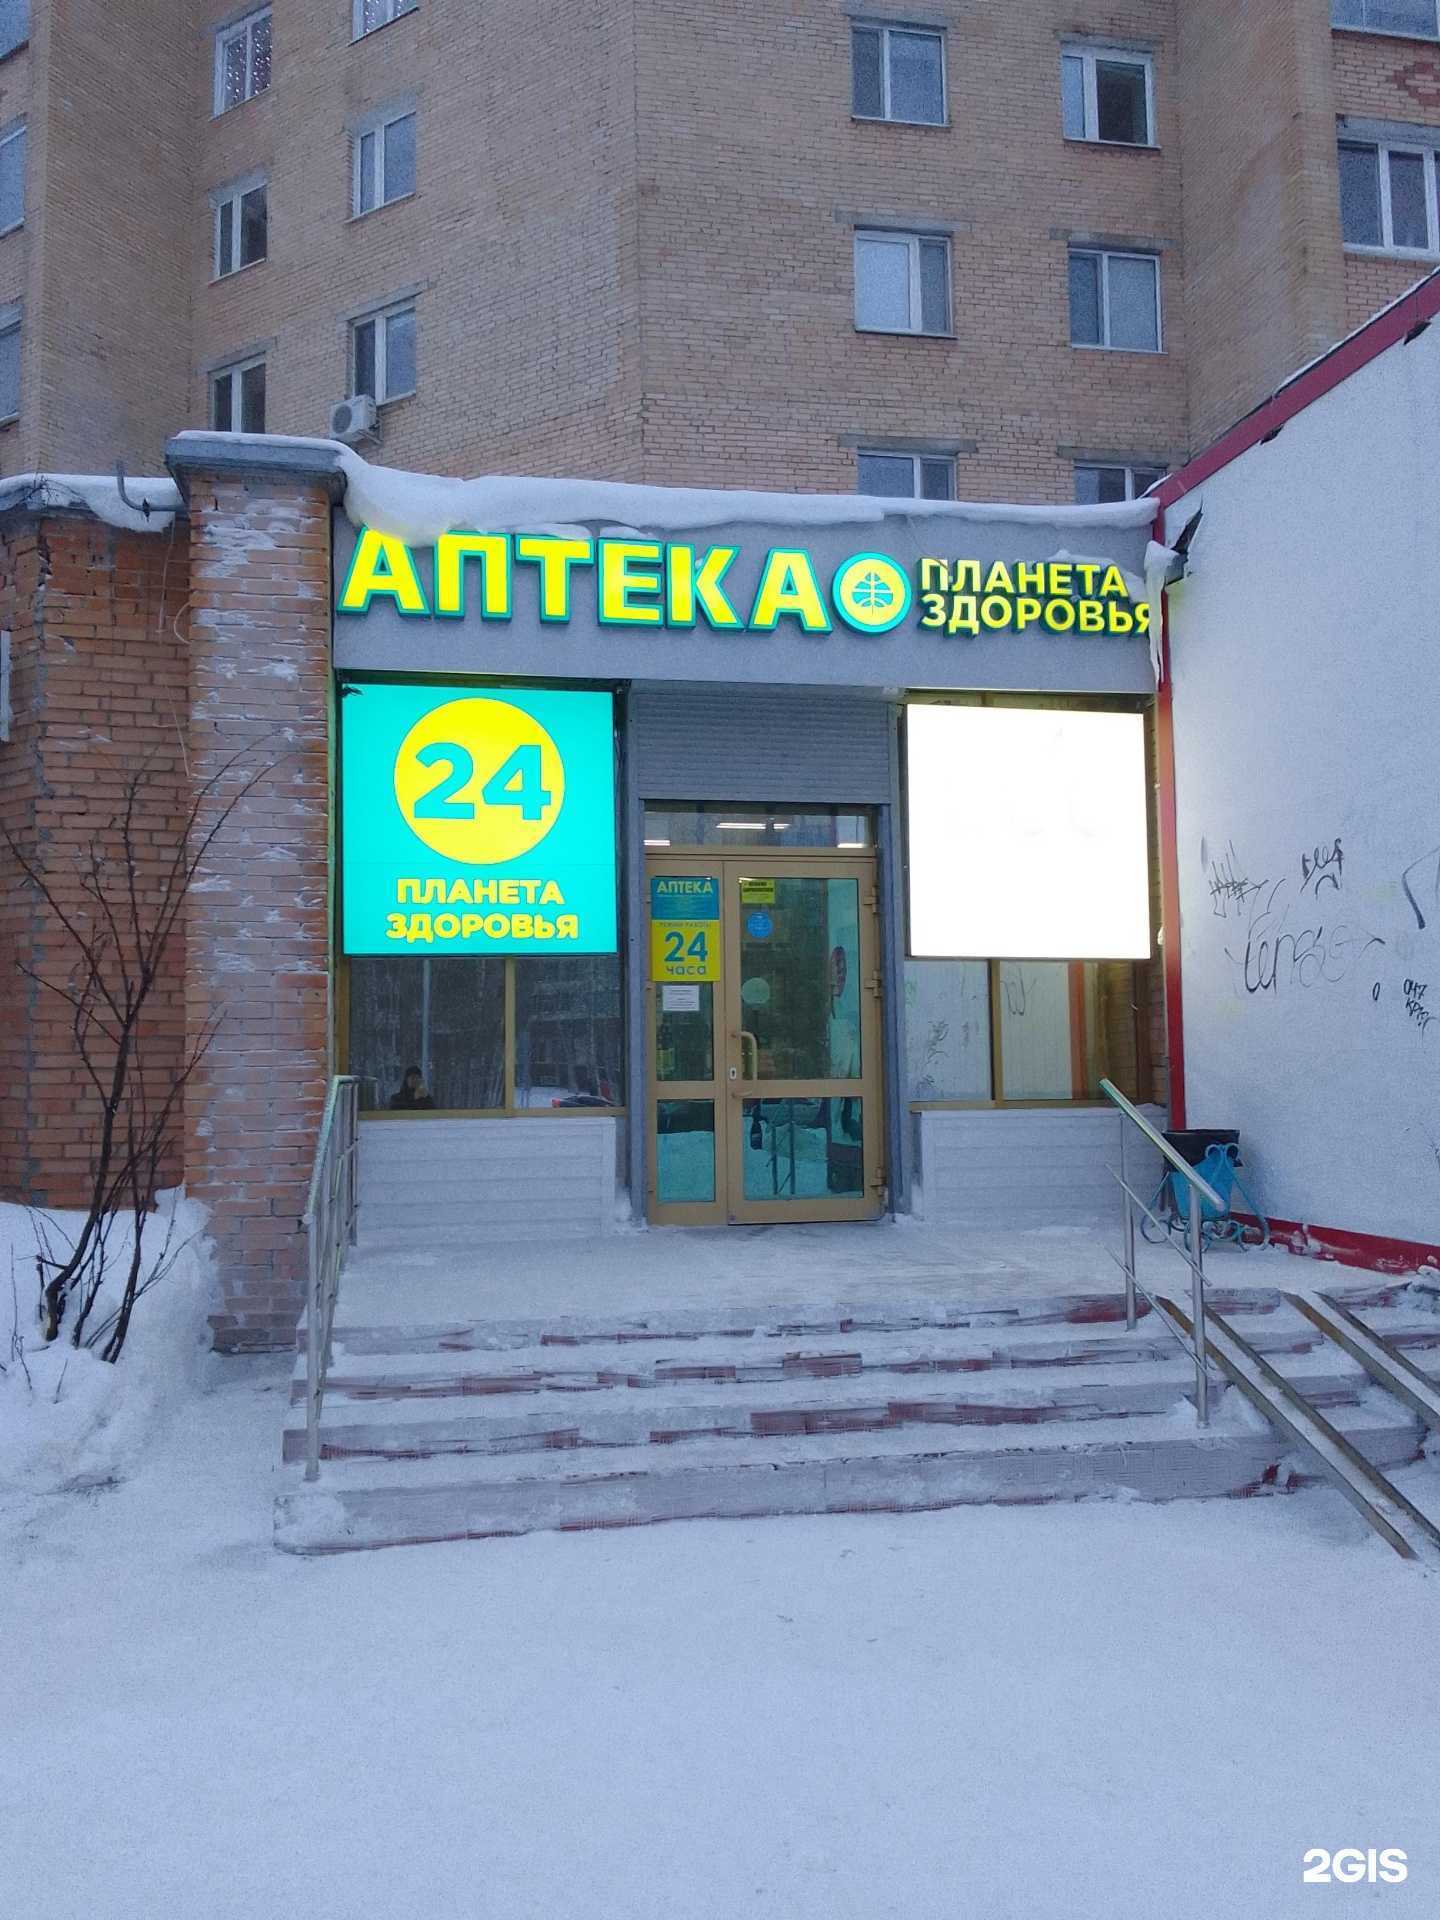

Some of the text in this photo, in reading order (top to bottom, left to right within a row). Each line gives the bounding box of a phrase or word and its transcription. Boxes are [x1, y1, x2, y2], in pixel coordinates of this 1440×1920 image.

[336, 526, 833, 634] АПТЕКА
[918, 557, 1129, 598] ПЛАНЕТА
[921, 595, 1149, 635] ЗДОРОВЬЯ
[414, 742, 551, 820] 24
[397, 879, 564, 904] ПЛАНЕТА
[657, 881, 712, 893] АПТЕКА
[385, 912, 579, 943] ЗДОРОВЬЯ
[664, 931, 708, 962] 24
